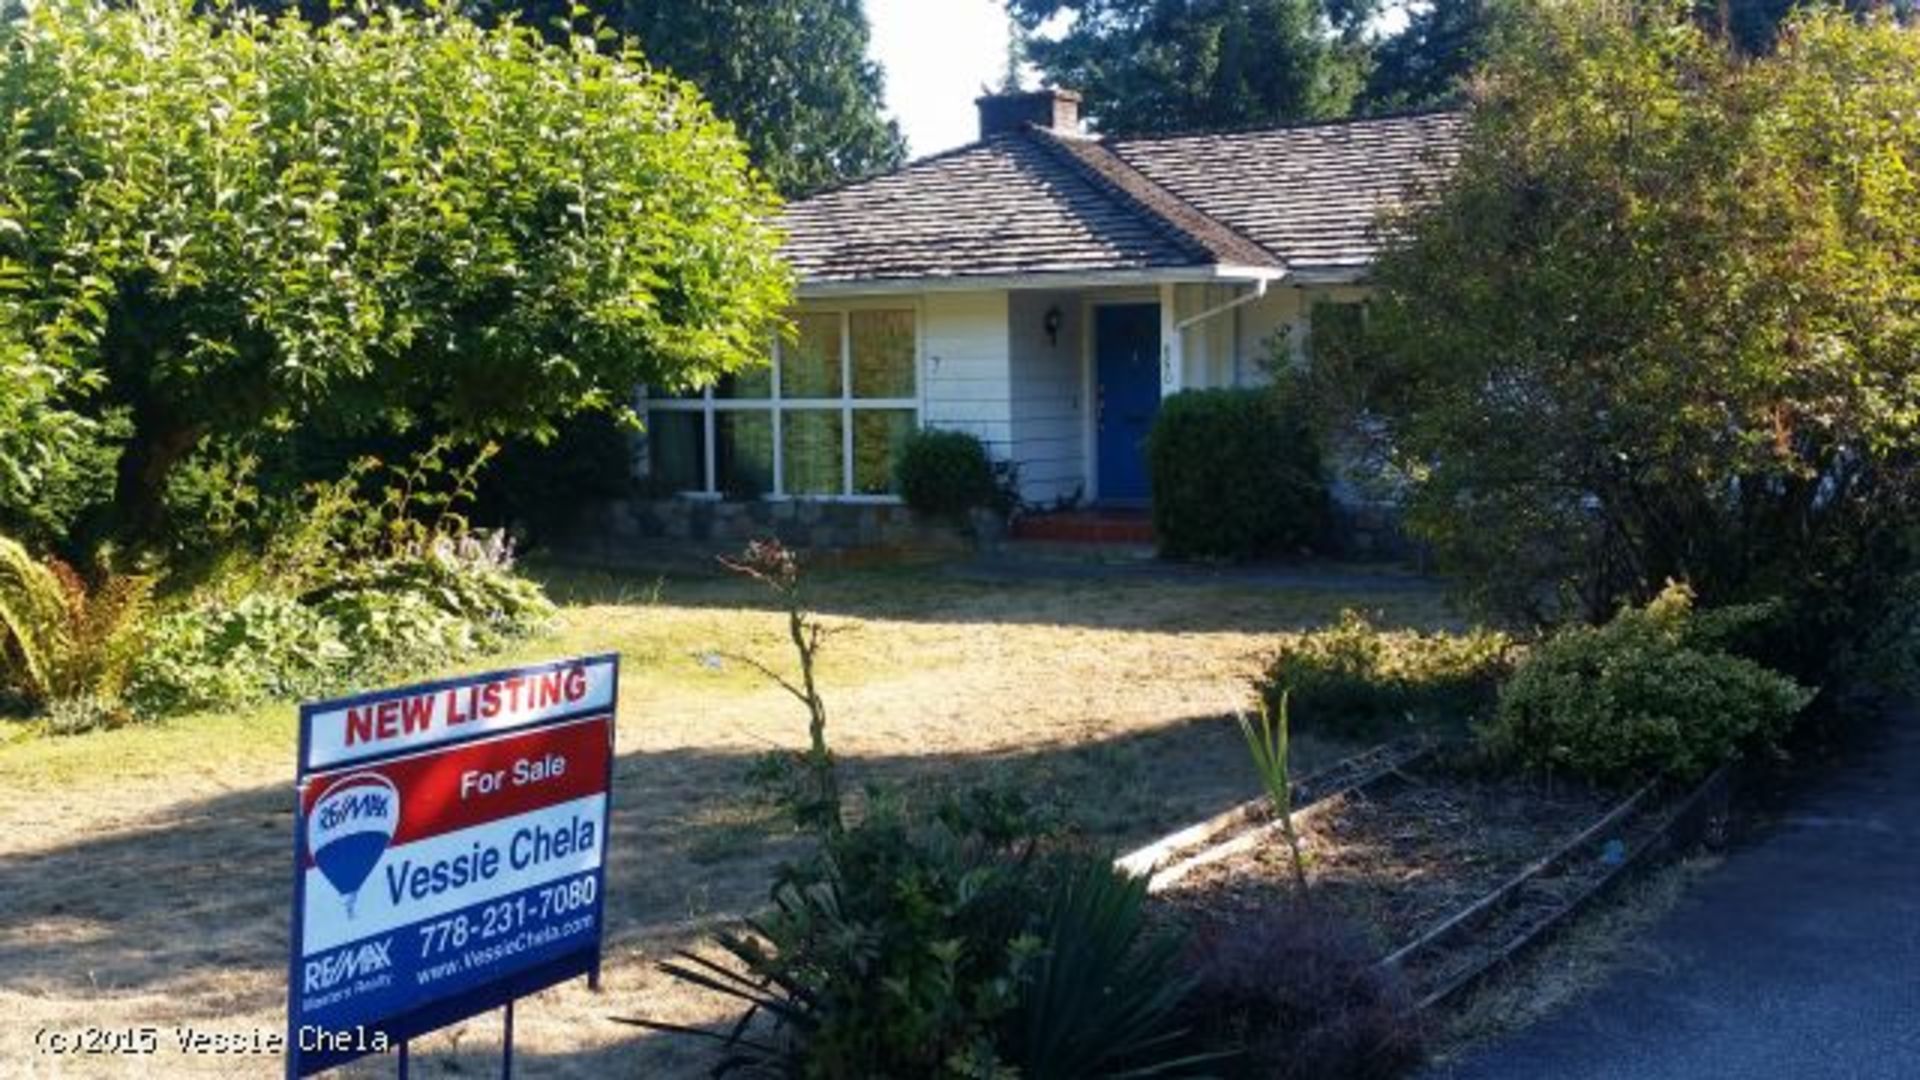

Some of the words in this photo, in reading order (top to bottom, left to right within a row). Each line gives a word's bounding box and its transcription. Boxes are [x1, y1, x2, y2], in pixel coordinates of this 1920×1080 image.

[344, 696, 435, 747] NEW
[446, 668, 586, 726] LISTING
[460, 770, 504, 801] For
[512, 754, 567, 784] Sale
[386, 841, 500, 906] Vessie
[509, 815, 595, 870] Chela
[416, 914, 596, 985] www.VessieChela.com
[419, 874, 597, 959] 778-231-7080
